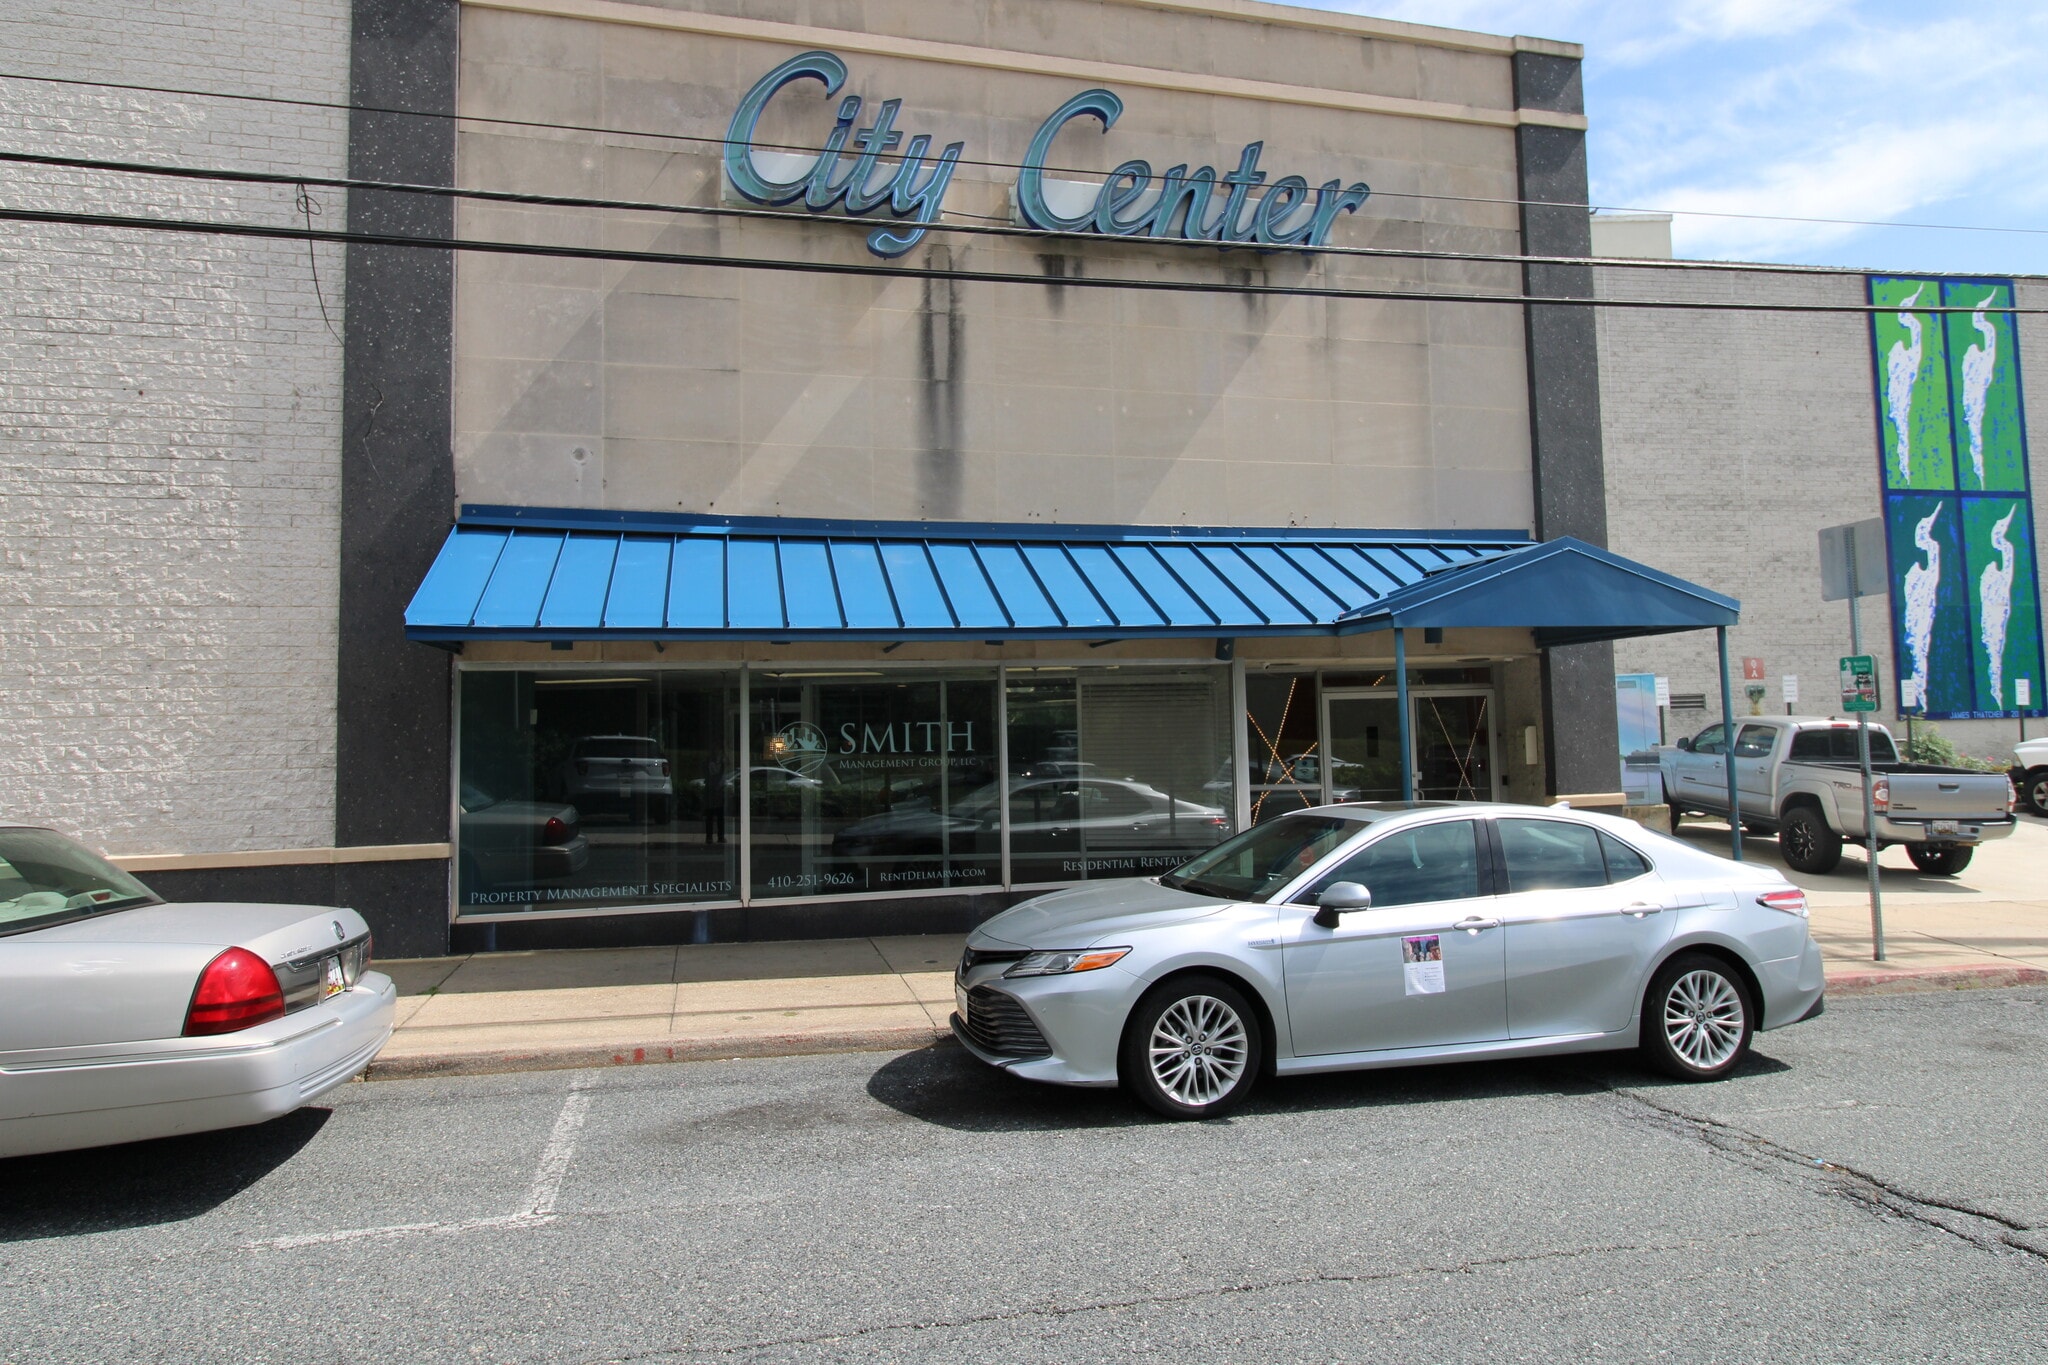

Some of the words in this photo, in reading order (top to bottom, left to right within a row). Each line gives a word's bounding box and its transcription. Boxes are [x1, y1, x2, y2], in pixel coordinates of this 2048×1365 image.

[723, 51, 965, 259] City
[1017, 88, 1370, 253] Center
[840, 721, 975, 755] SMITH
[960, 757, 977, 766] LLC
[768, 872, 855, 888] 410-251-9626
